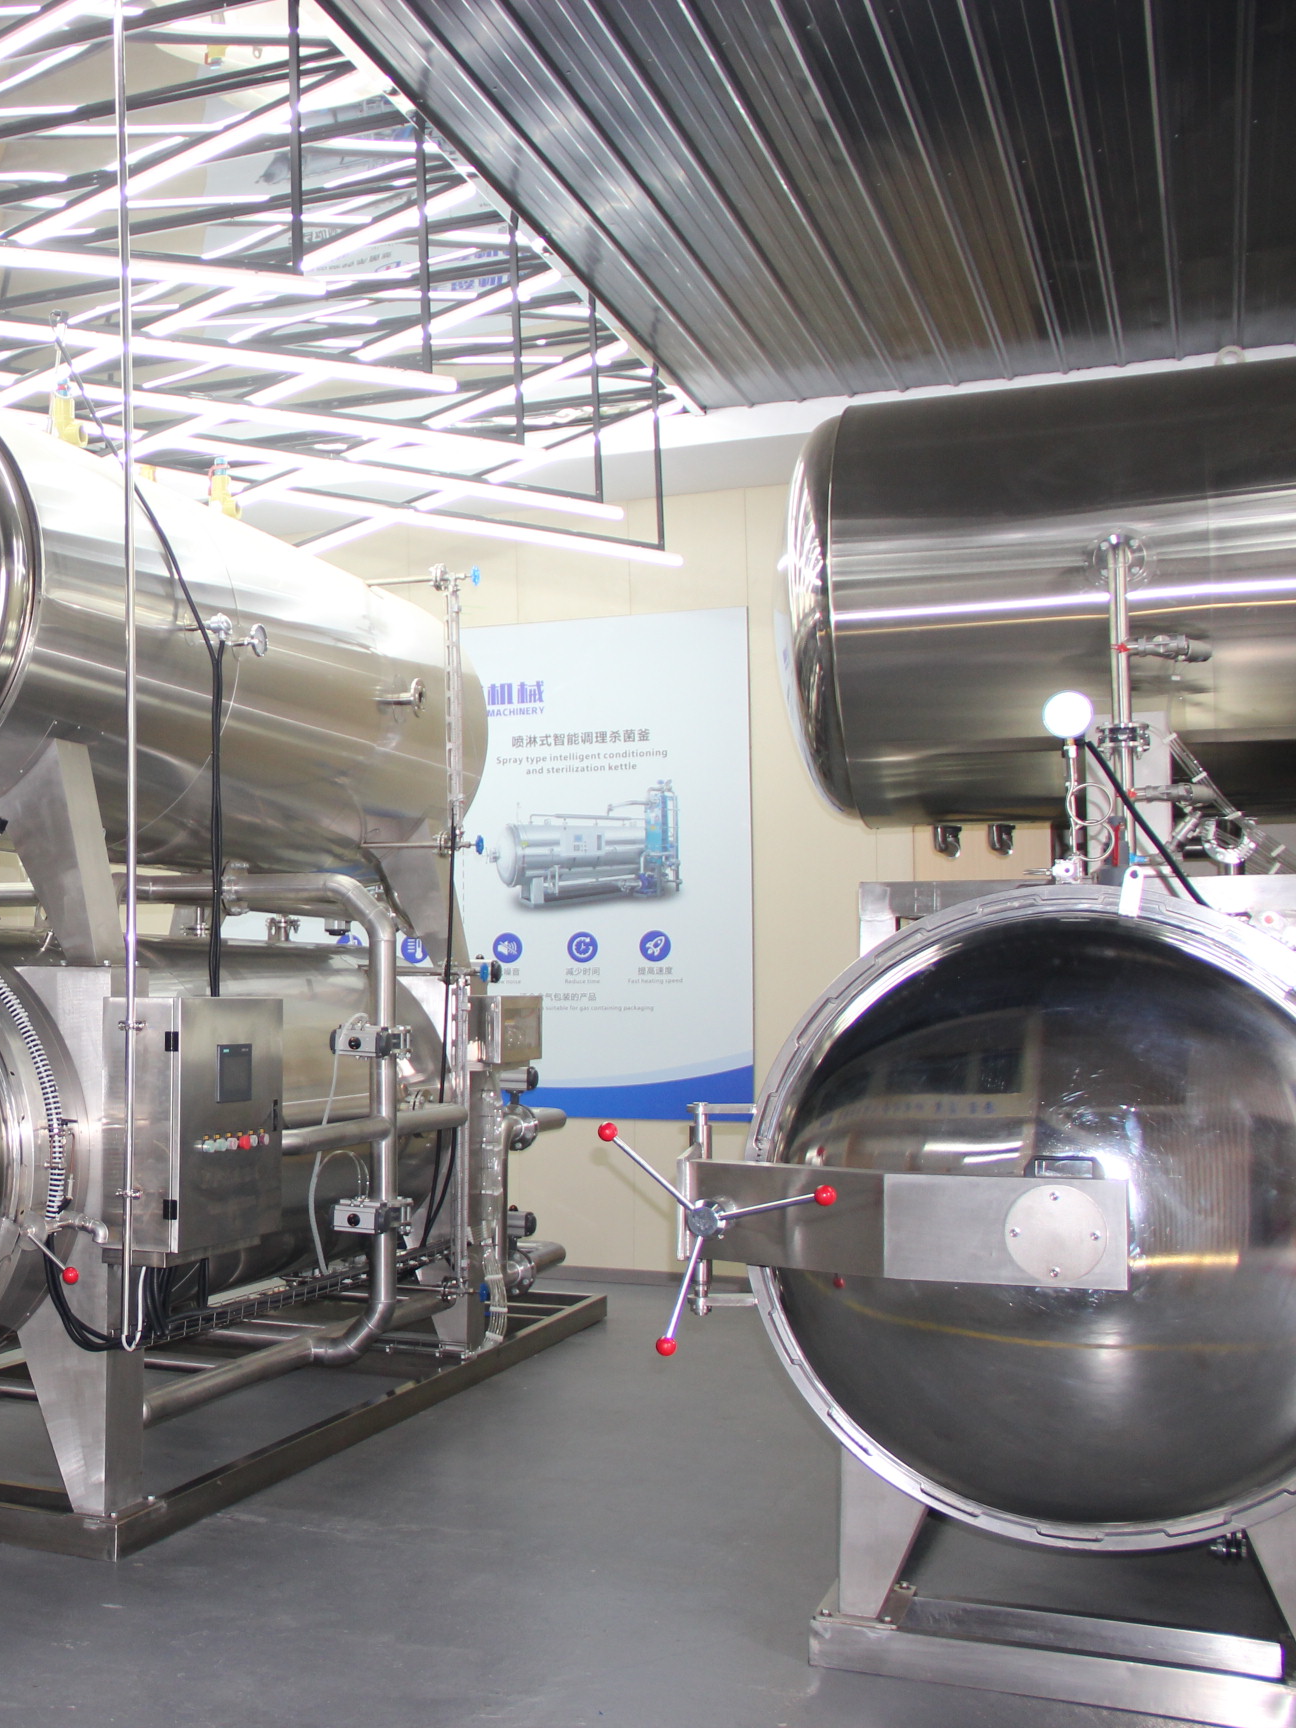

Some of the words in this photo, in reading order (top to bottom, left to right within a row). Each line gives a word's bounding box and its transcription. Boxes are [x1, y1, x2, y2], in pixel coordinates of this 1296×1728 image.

[482, 680, 545, 706] 机械
[487, 706, 545, 717] MACHINERY
[511, 728, 651, 748] 喷淋式智能调理杀菌釜
[496, 756, 523, 765] Spray
[526, 755, 547, 765] type
[549, 752, 601, 762] intelligent
[603, 748, 668, 759] conditioning
[526, 766, 544, 775] and
[546, 763, 605, 774] sterilization
[608, 761, 638, 771] kettle
[501, 967, 521, 976] 噪音
[565, 966, 601, 976] 减少时间
[637, 966, 673, 976] 提高速度
[665, 977, 684, 985] speed
